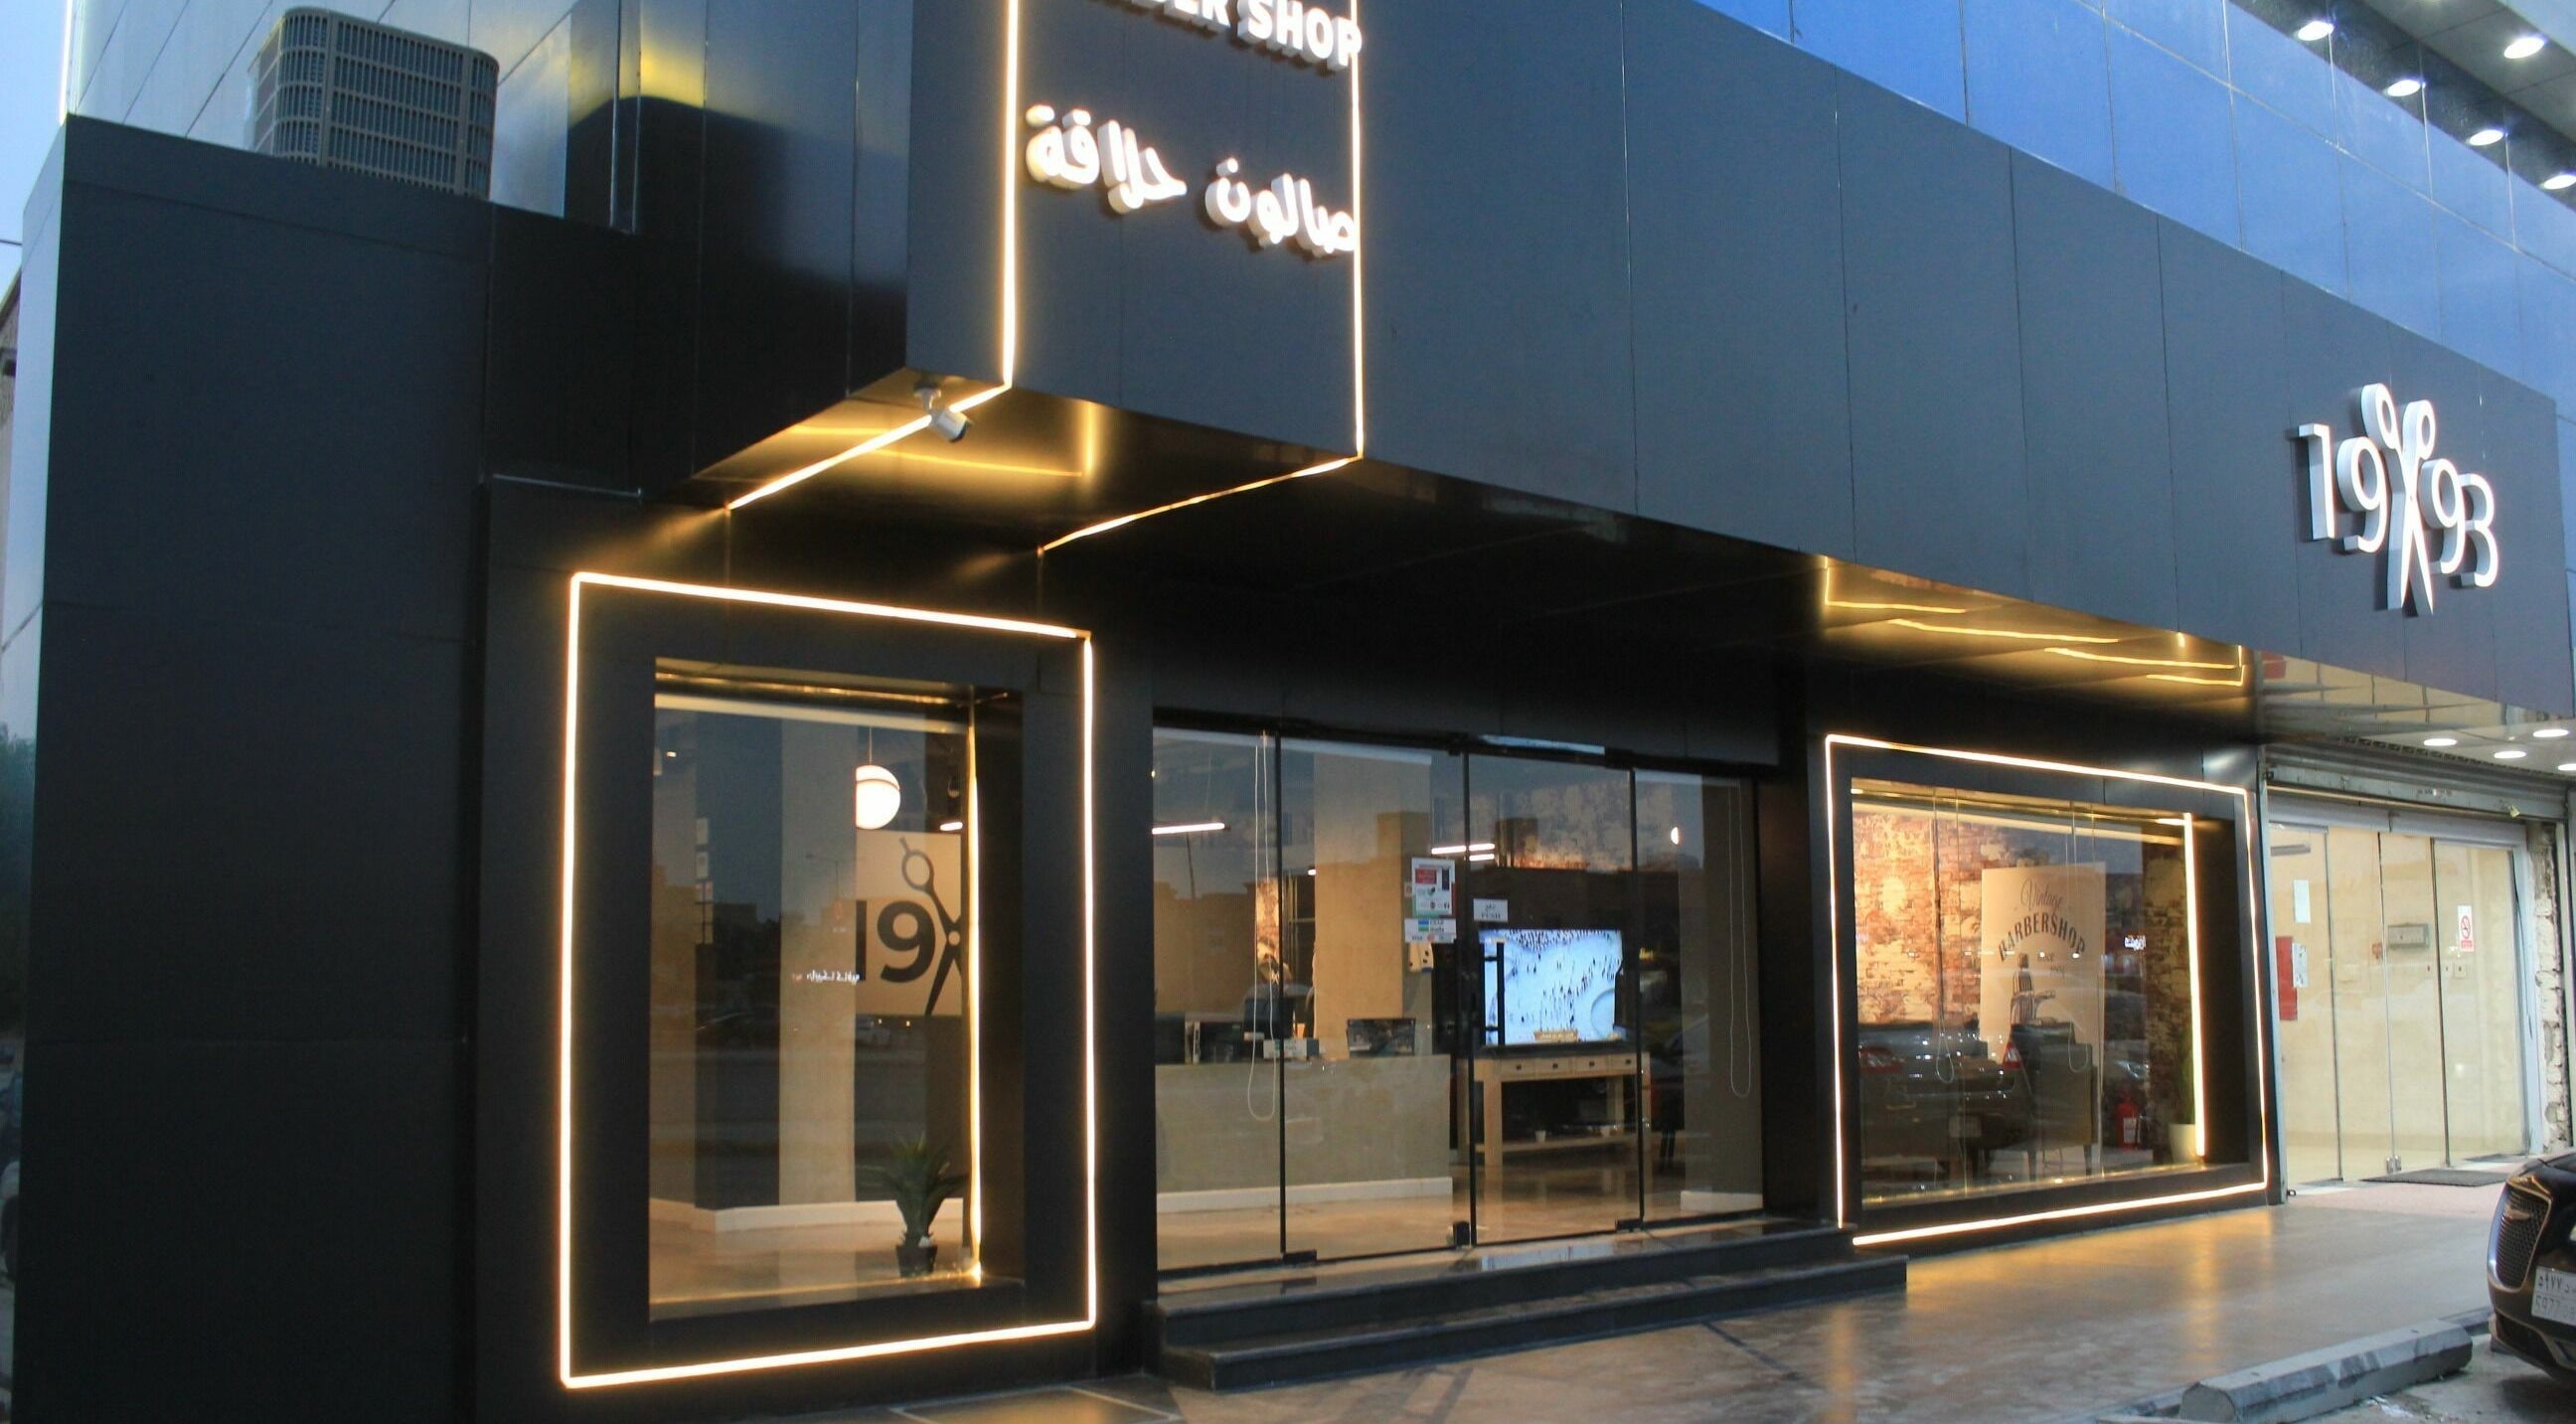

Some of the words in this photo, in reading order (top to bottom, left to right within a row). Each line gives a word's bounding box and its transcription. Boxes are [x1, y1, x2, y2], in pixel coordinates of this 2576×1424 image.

[1237, 0, 1363, 71] SHOP
[1026, 104, 1187, 215] حلاقة
[1206, 158, 1356, 257] صالون
[1999, 911, 2086, 962] BARBERSHOP
